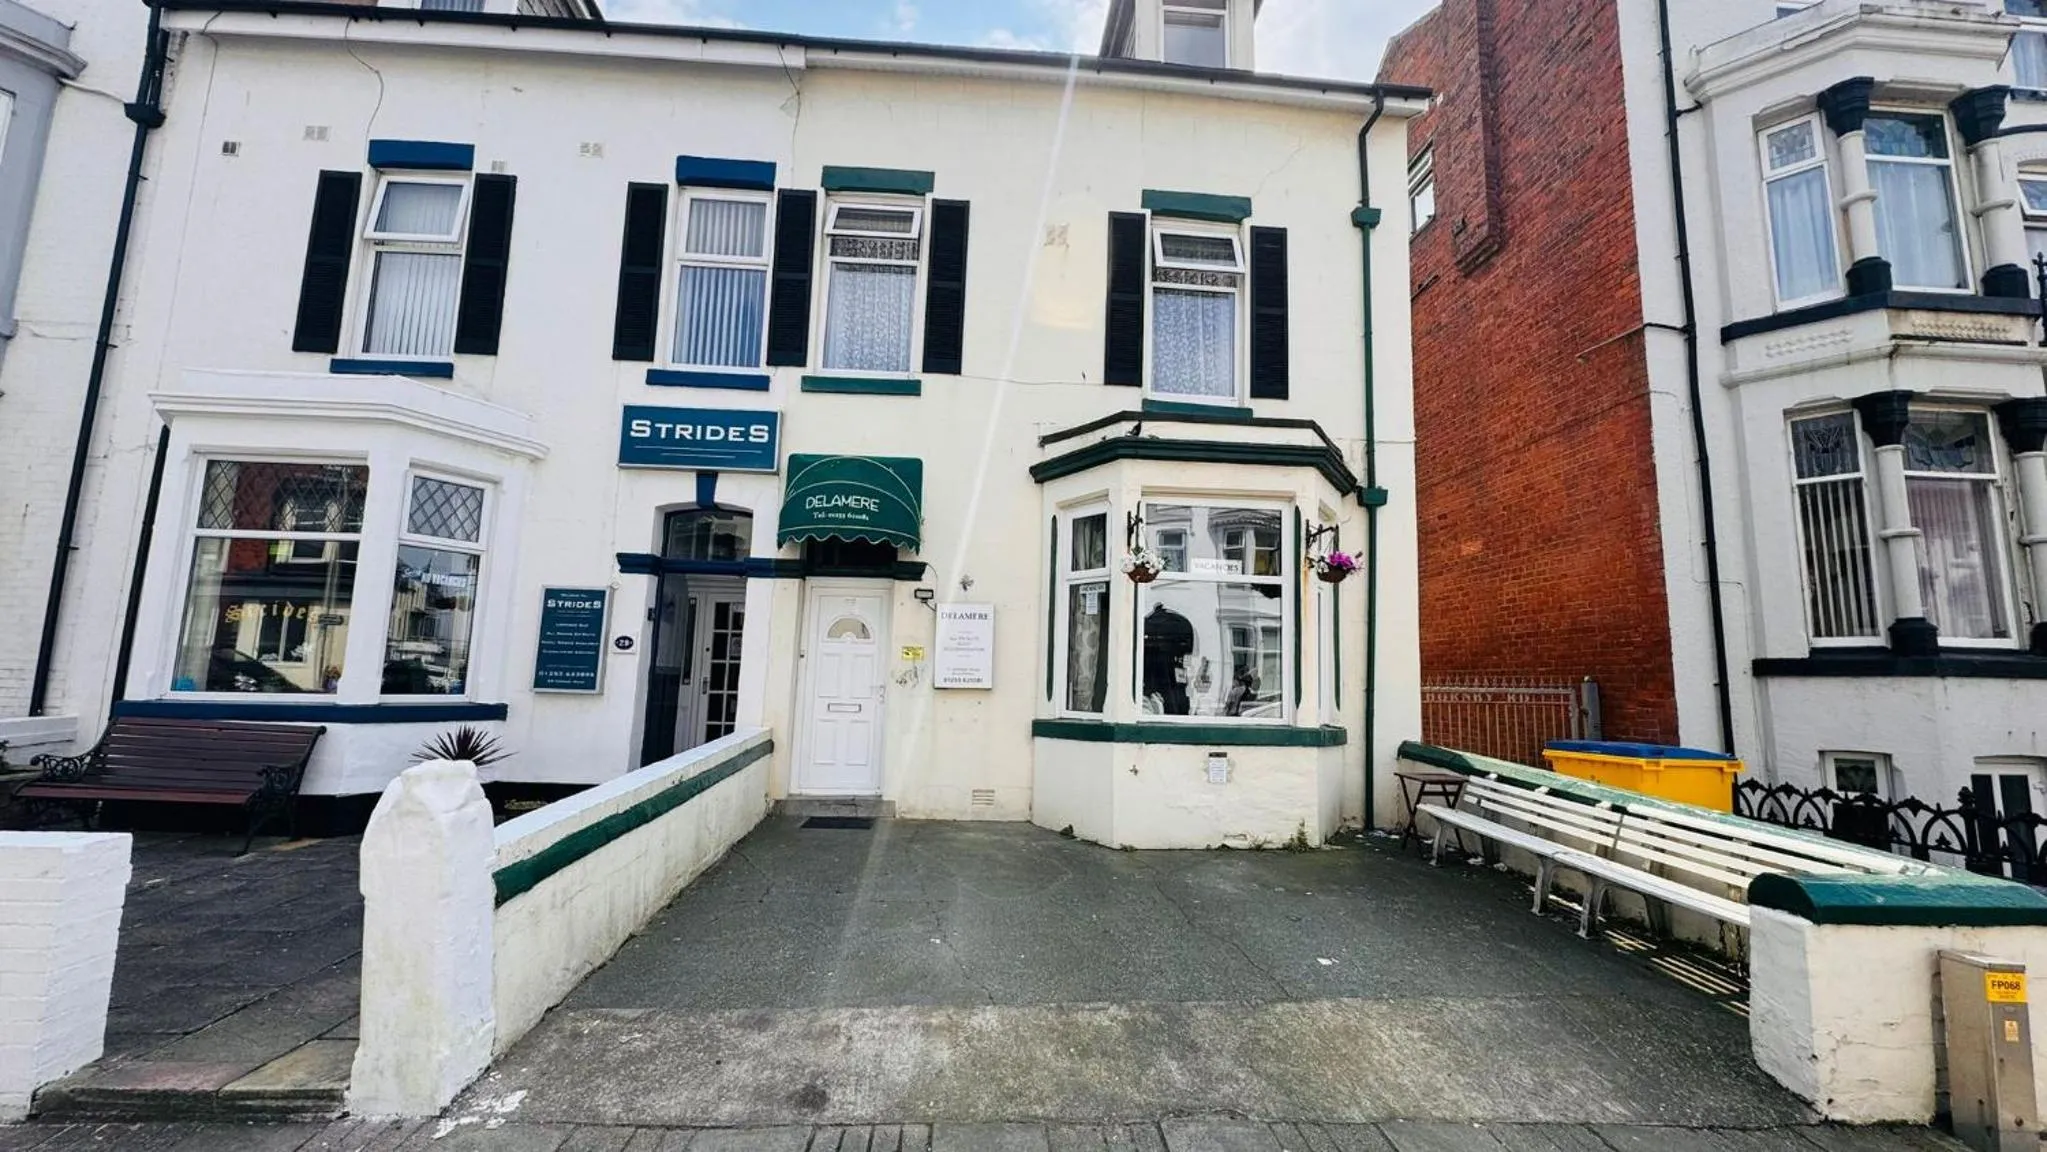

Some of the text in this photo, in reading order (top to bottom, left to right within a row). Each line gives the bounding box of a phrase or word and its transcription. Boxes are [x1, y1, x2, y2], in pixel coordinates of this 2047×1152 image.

[630, 419, 769, 443] STRIDES
[805, 494, 880, 512] DELAMERE
[547, 599, 601, 609] STRIDES
[941, 611, 988, 620] DELAMERE
